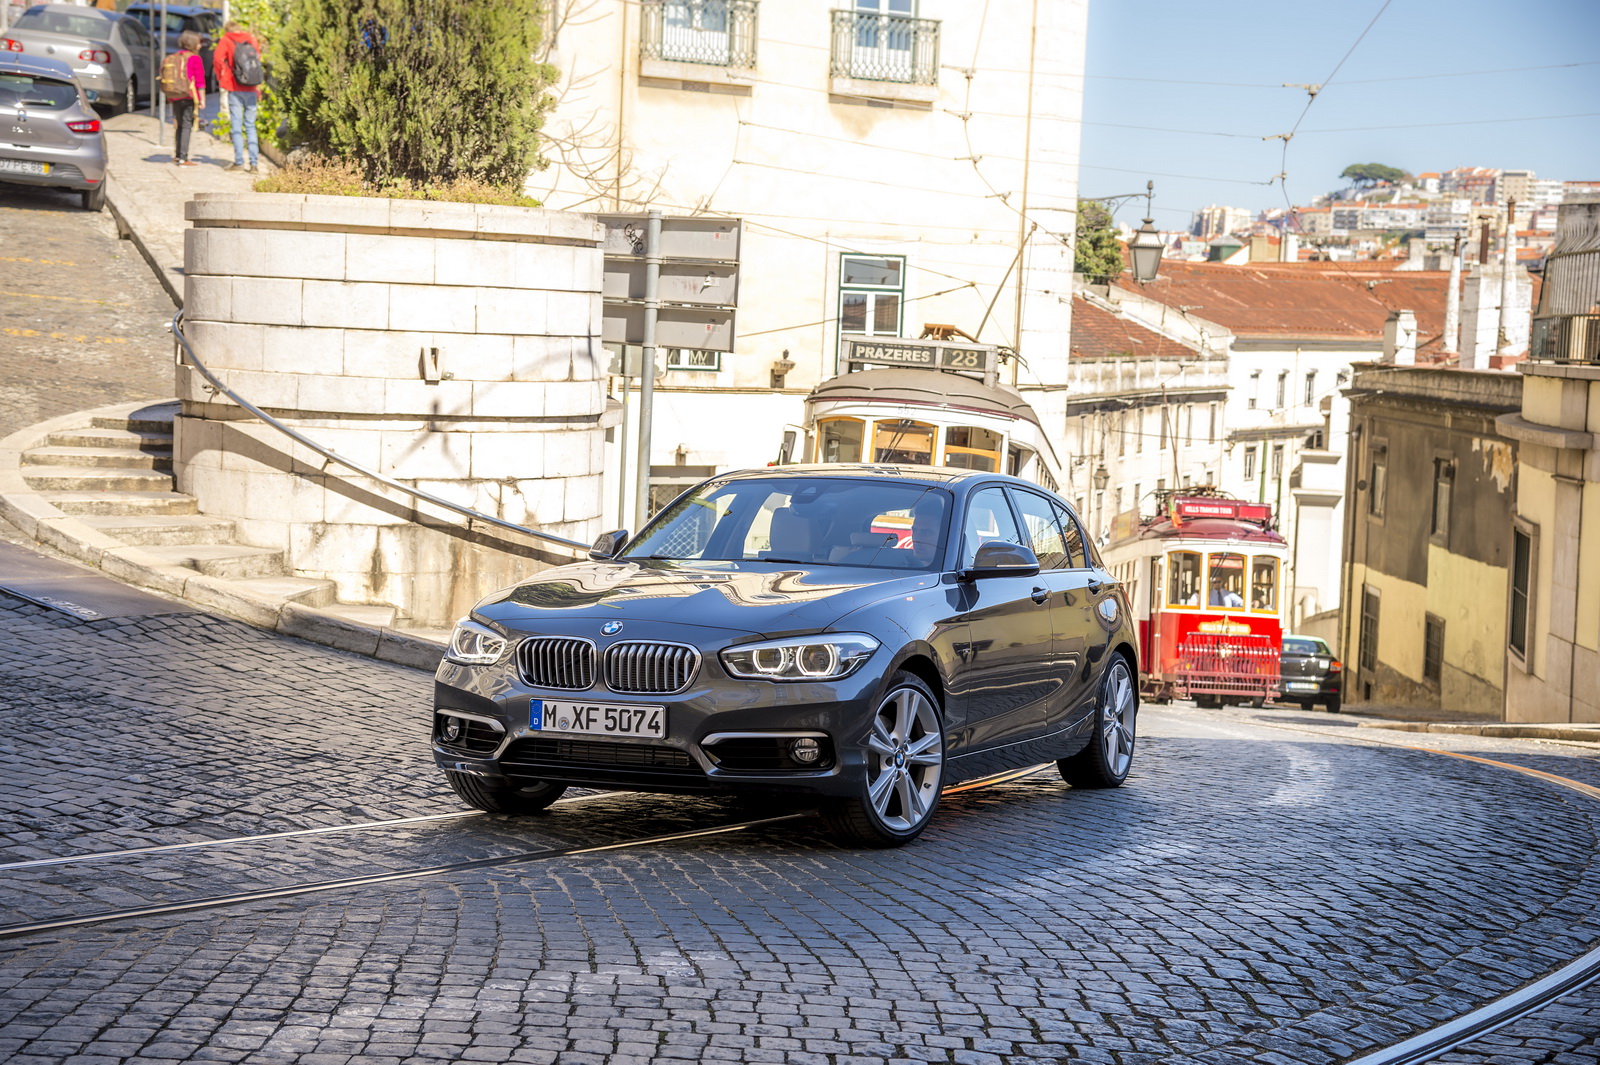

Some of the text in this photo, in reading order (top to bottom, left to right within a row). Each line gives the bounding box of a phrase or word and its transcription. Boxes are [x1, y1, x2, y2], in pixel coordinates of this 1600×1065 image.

[855, 345, 931, 363] PRAZERES
[951, 350, 978, 367] 28
[533, 703, 661, 734] D M XF 5074
